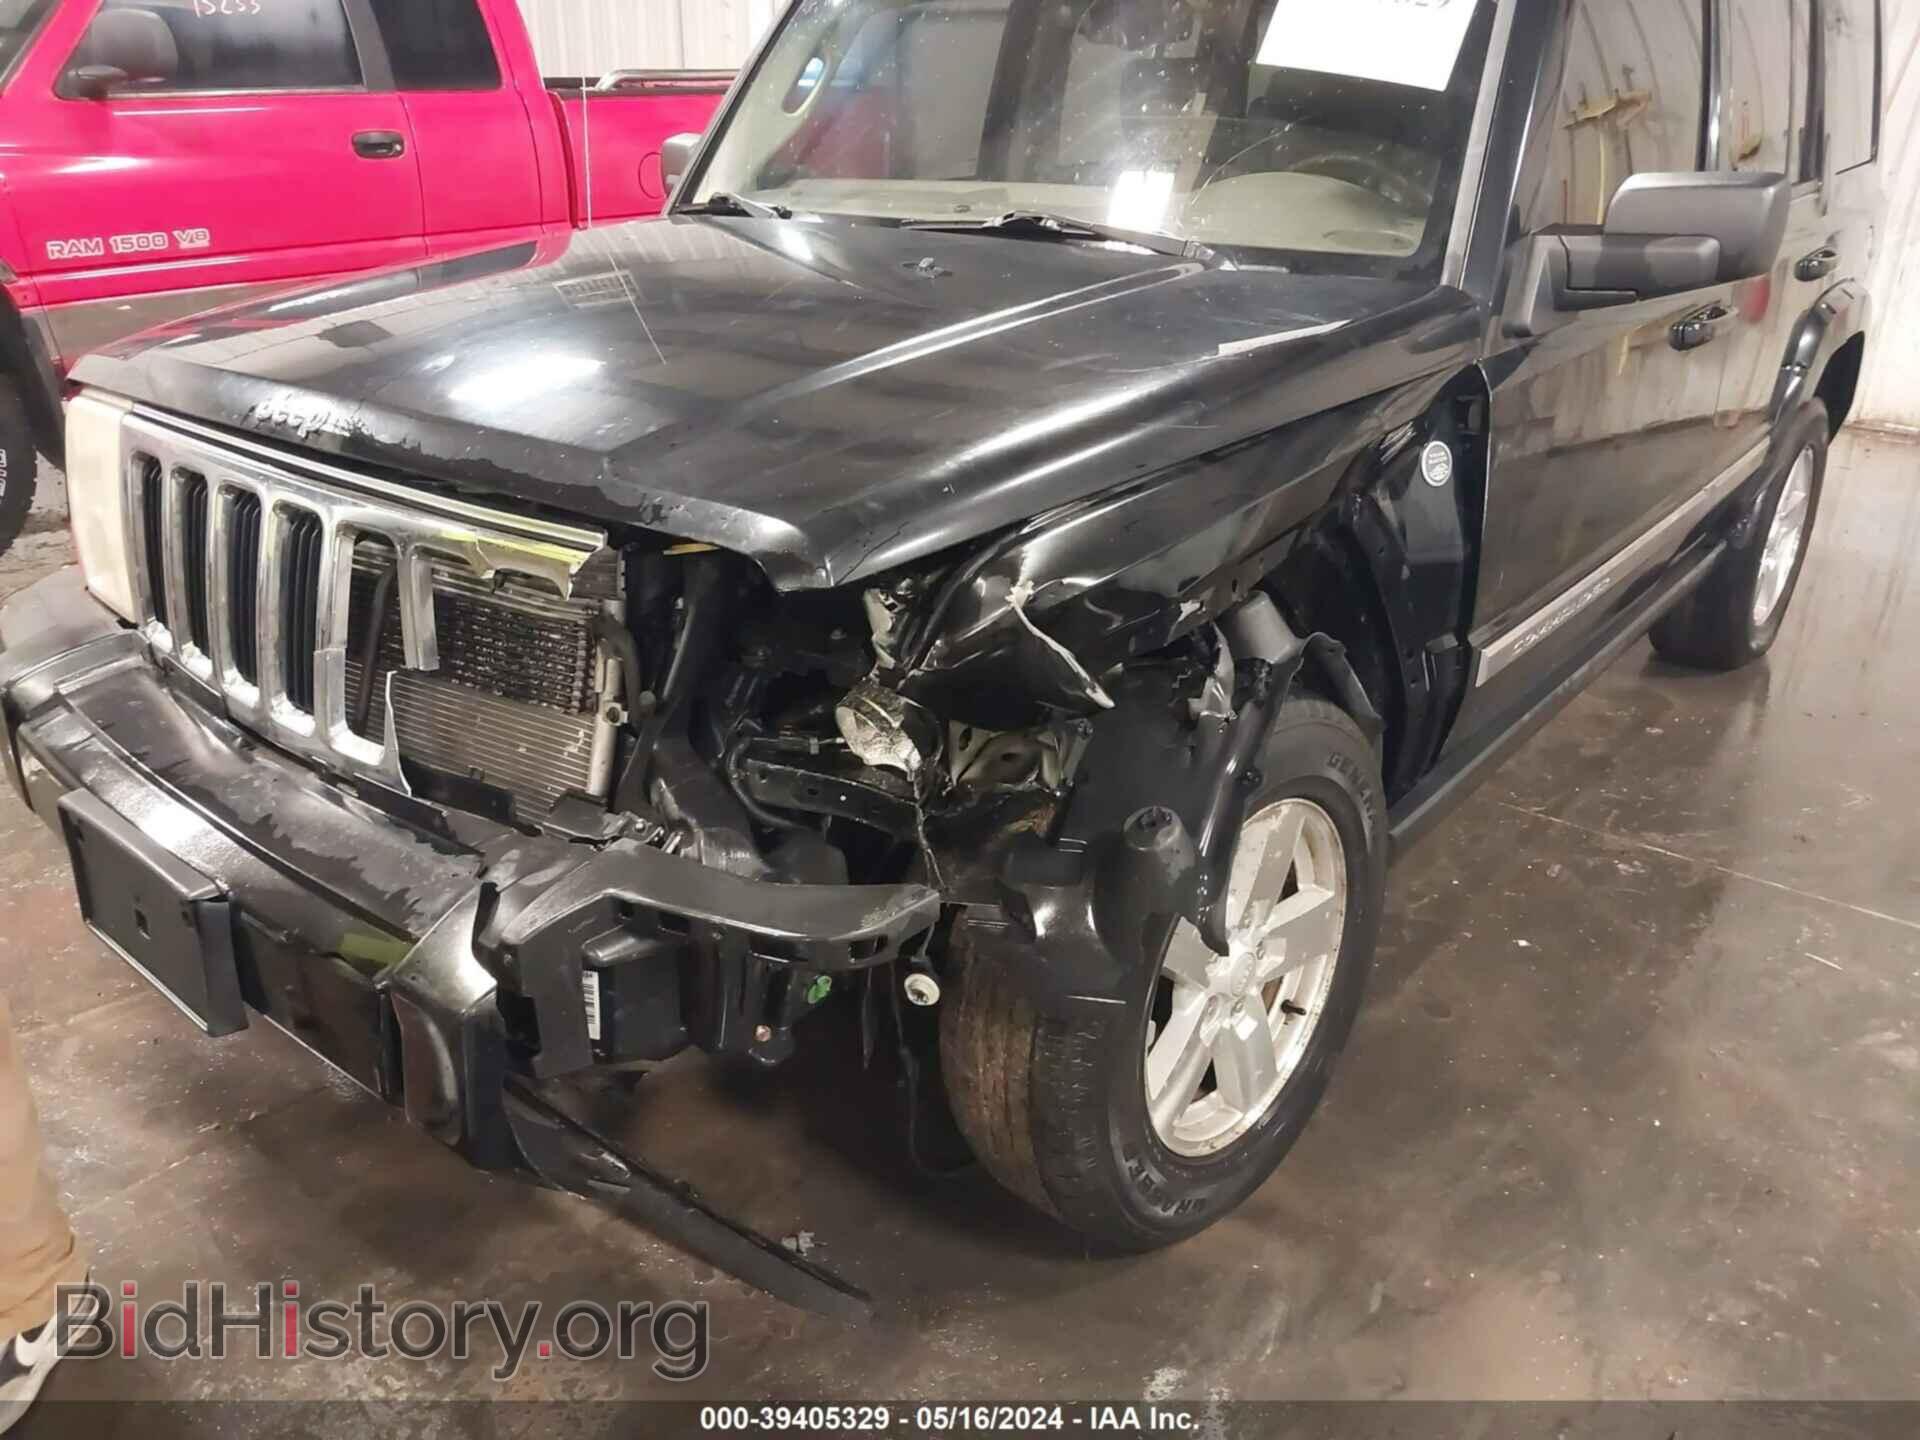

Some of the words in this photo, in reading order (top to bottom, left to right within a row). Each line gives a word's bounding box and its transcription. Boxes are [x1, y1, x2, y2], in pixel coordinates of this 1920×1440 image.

[46, 237, 104, 260] RAM
[110, 231, 168, 253] 1500
[172, 228, 210, 249] V8
